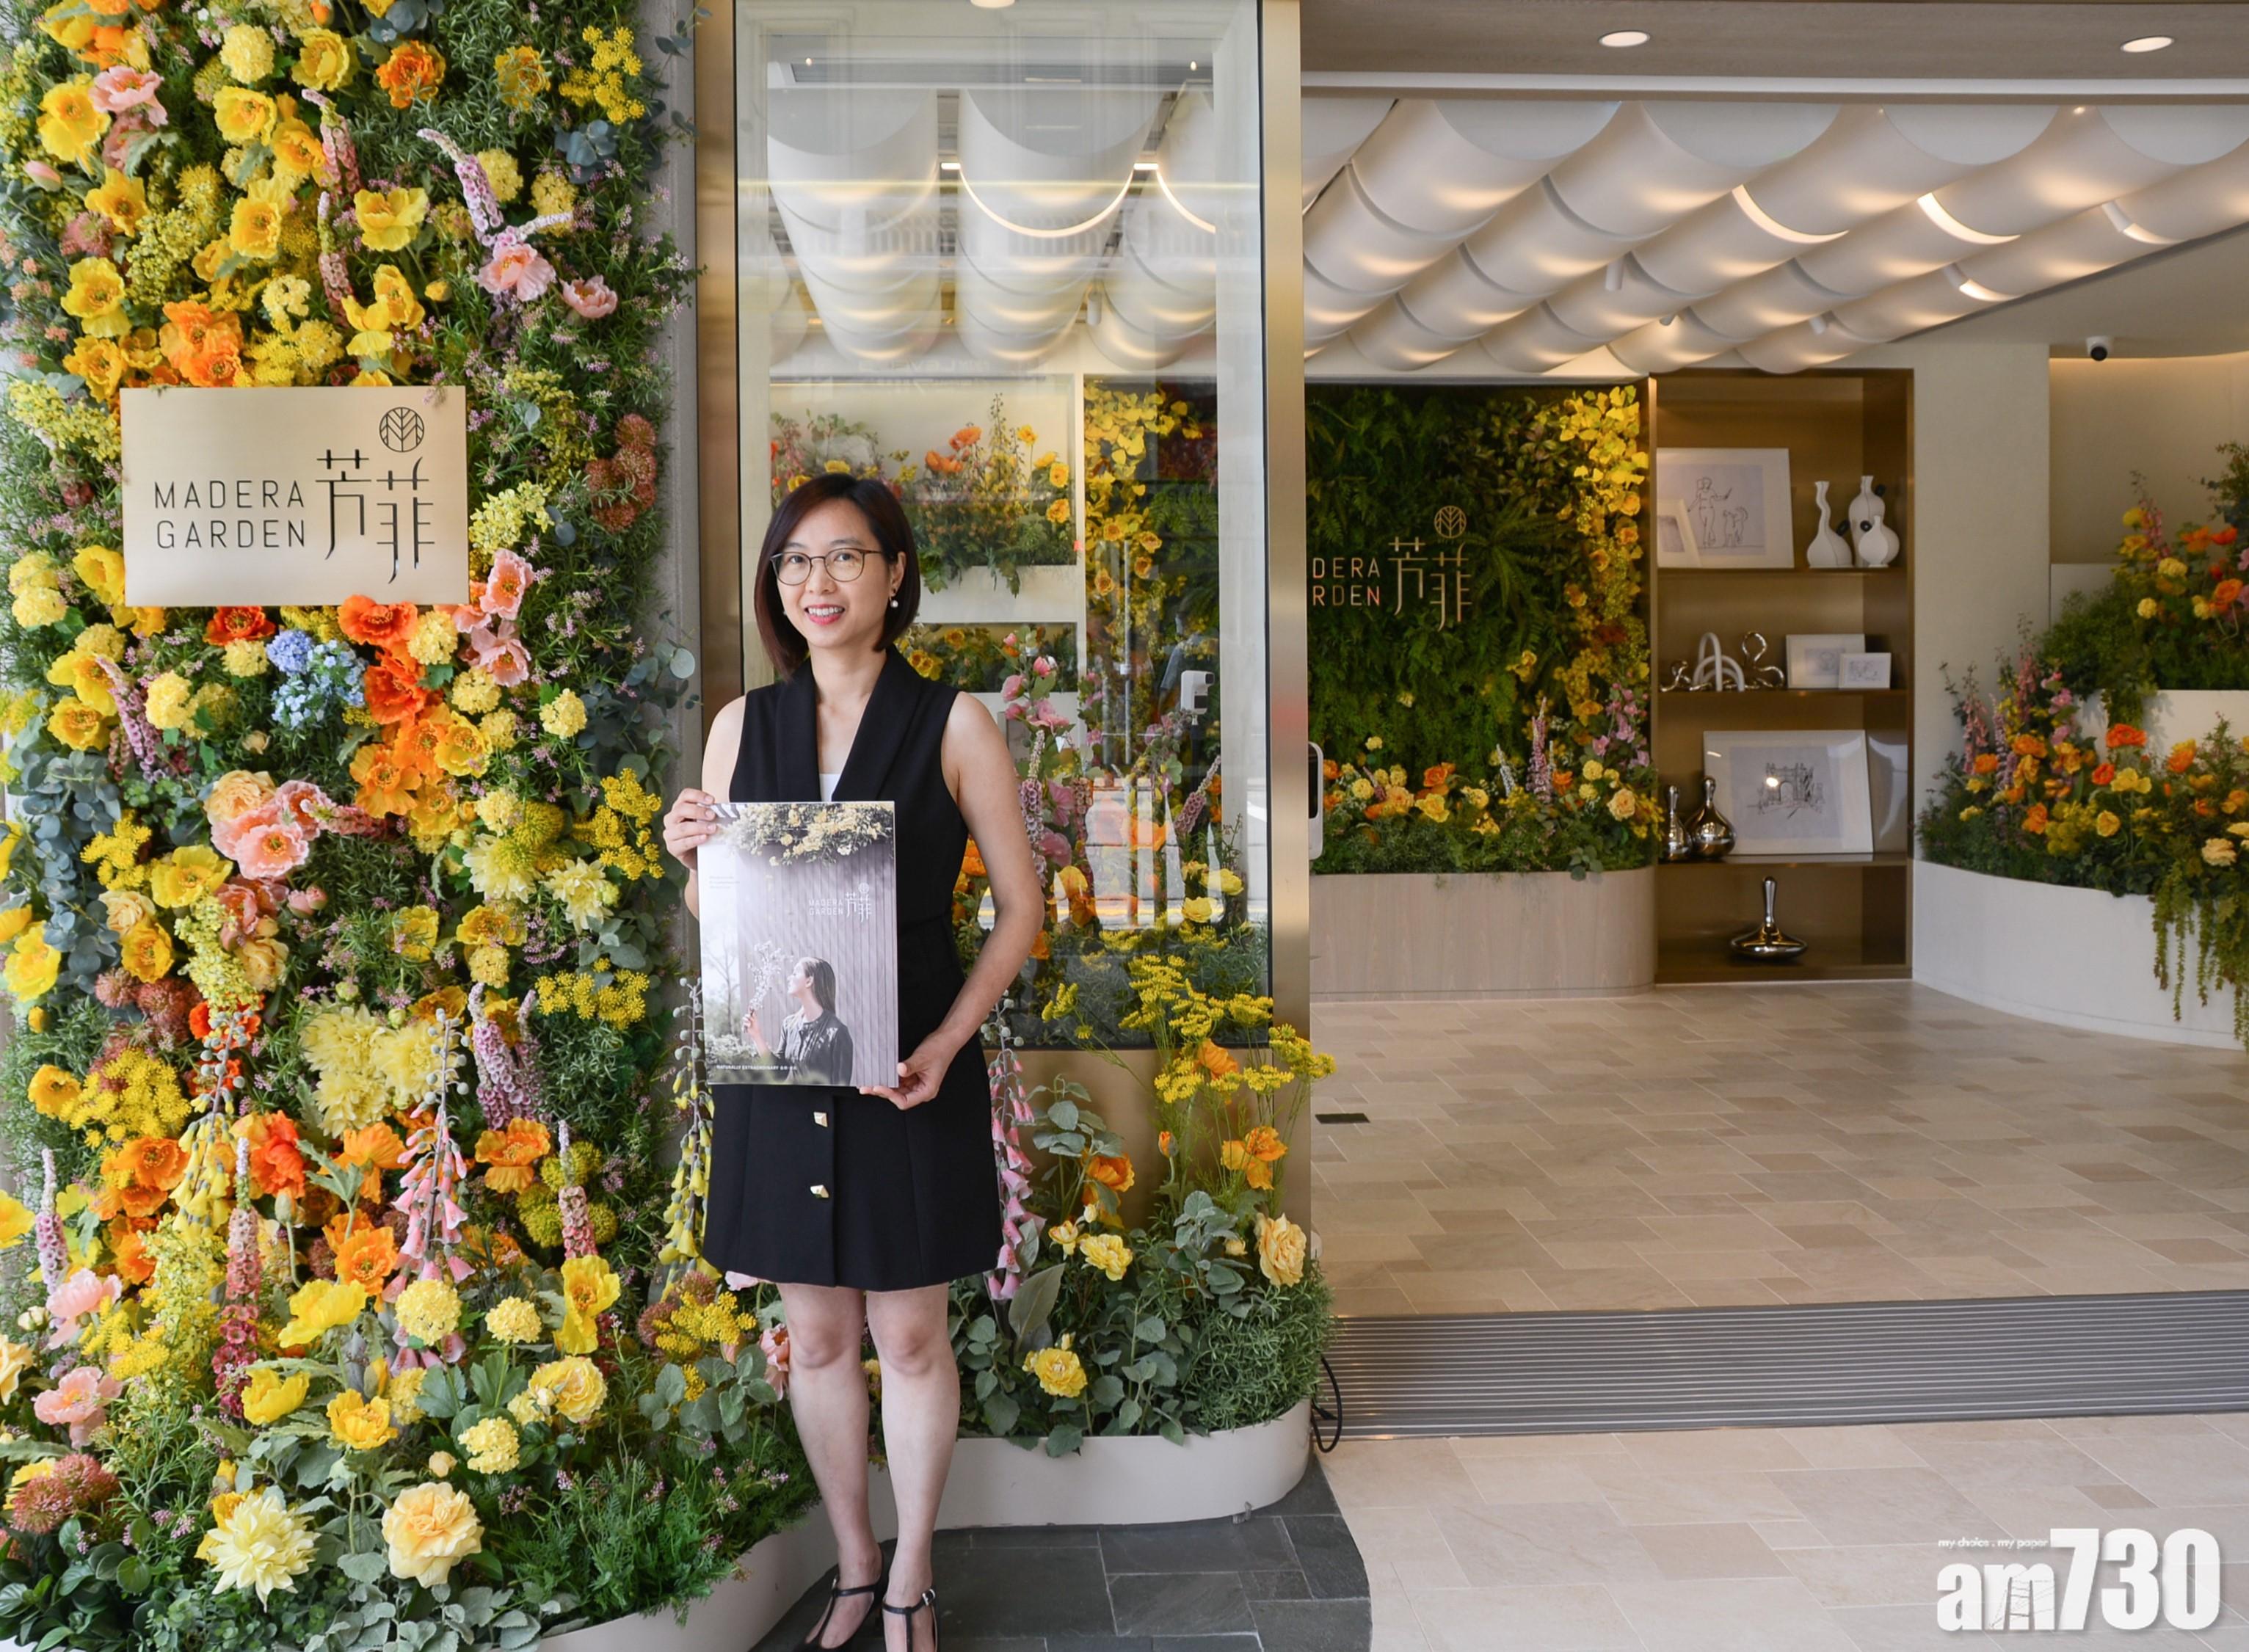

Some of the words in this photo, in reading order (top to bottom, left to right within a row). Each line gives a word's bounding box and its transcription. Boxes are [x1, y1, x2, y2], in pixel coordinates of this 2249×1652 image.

[154, 480, 305, 509] MADERA
[316, 448, 435, 584] 芳菲
[156, 520, 305, 549] GARDEN
[1387, 536, 1472, 633] 芳菲
[809, 898, 843, 906] MADERA
[809, 907, 843, 915] GARDEN
